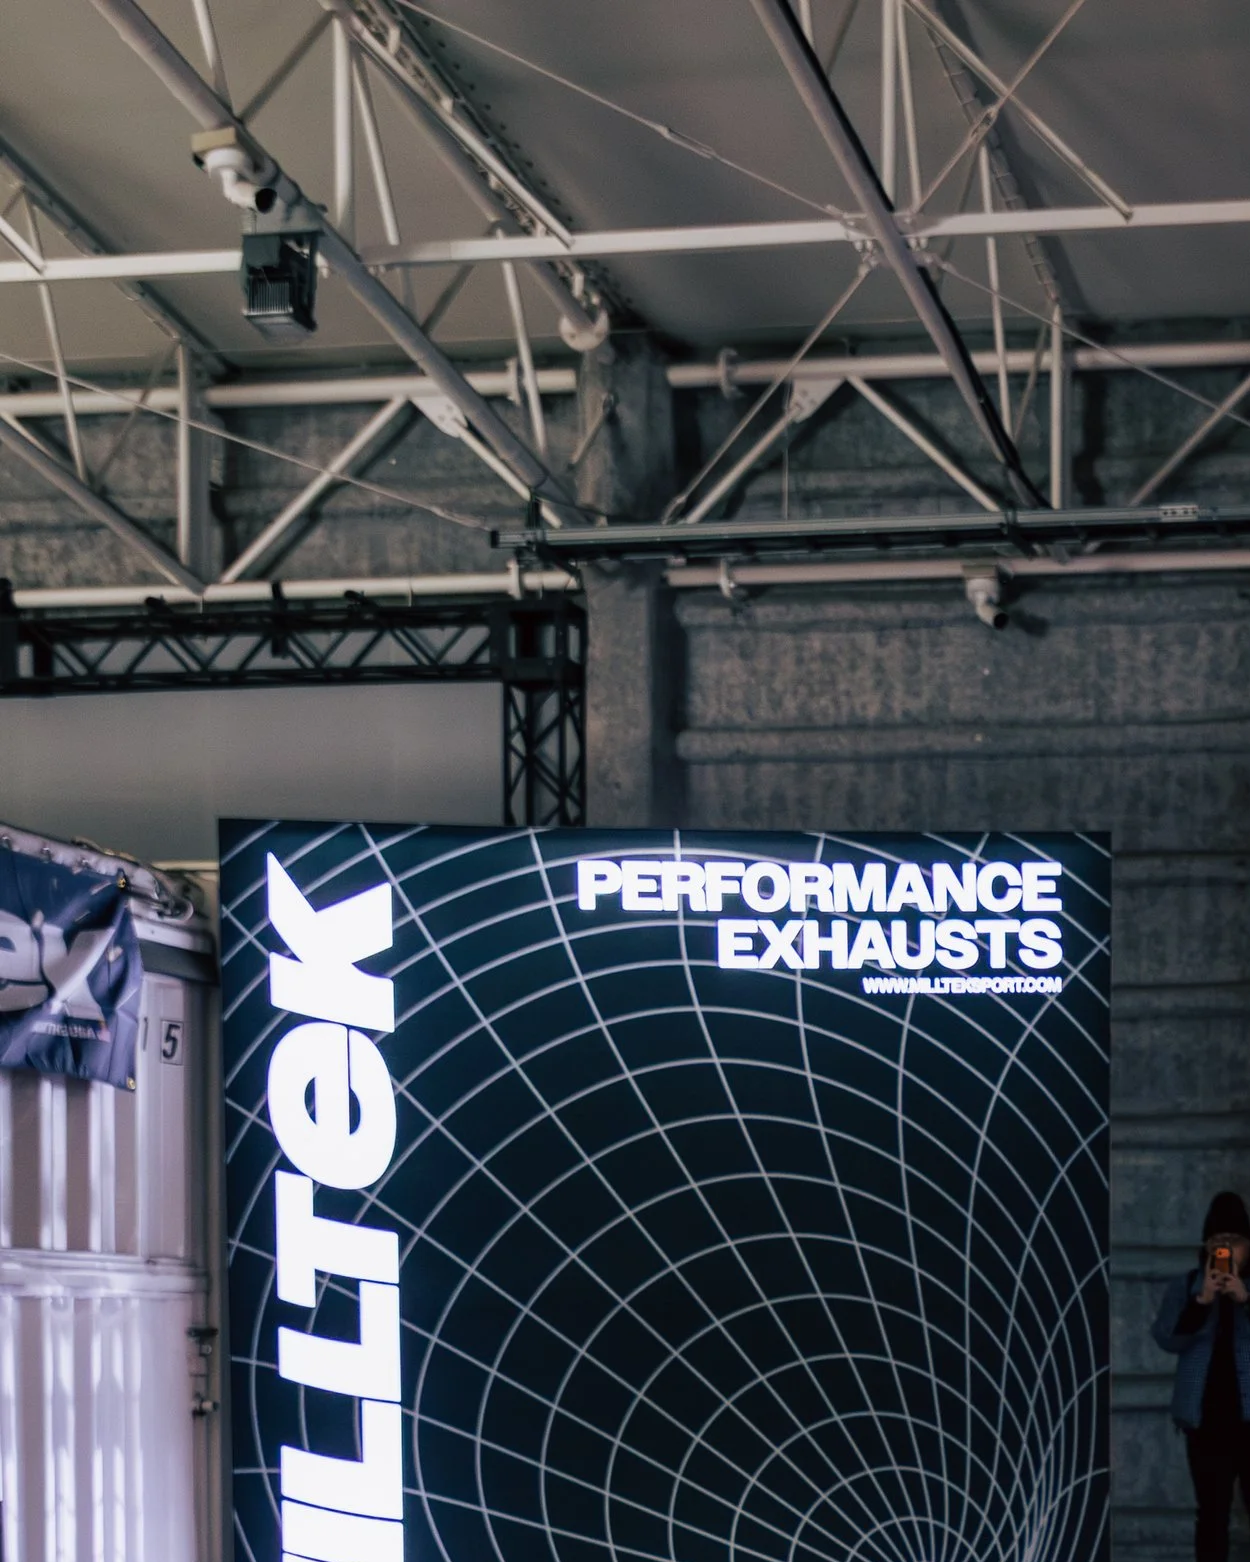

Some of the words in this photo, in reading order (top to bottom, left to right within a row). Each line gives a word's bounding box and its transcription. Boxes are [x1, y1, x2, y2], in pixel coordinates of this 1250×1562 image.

[576, 859, 1063, 912] PERFORMANCE
[716, 918, 1063, 970] EXHAUSTS
[862, 976, 1063, 994] WWW.MILLTEKSPORT.COM
